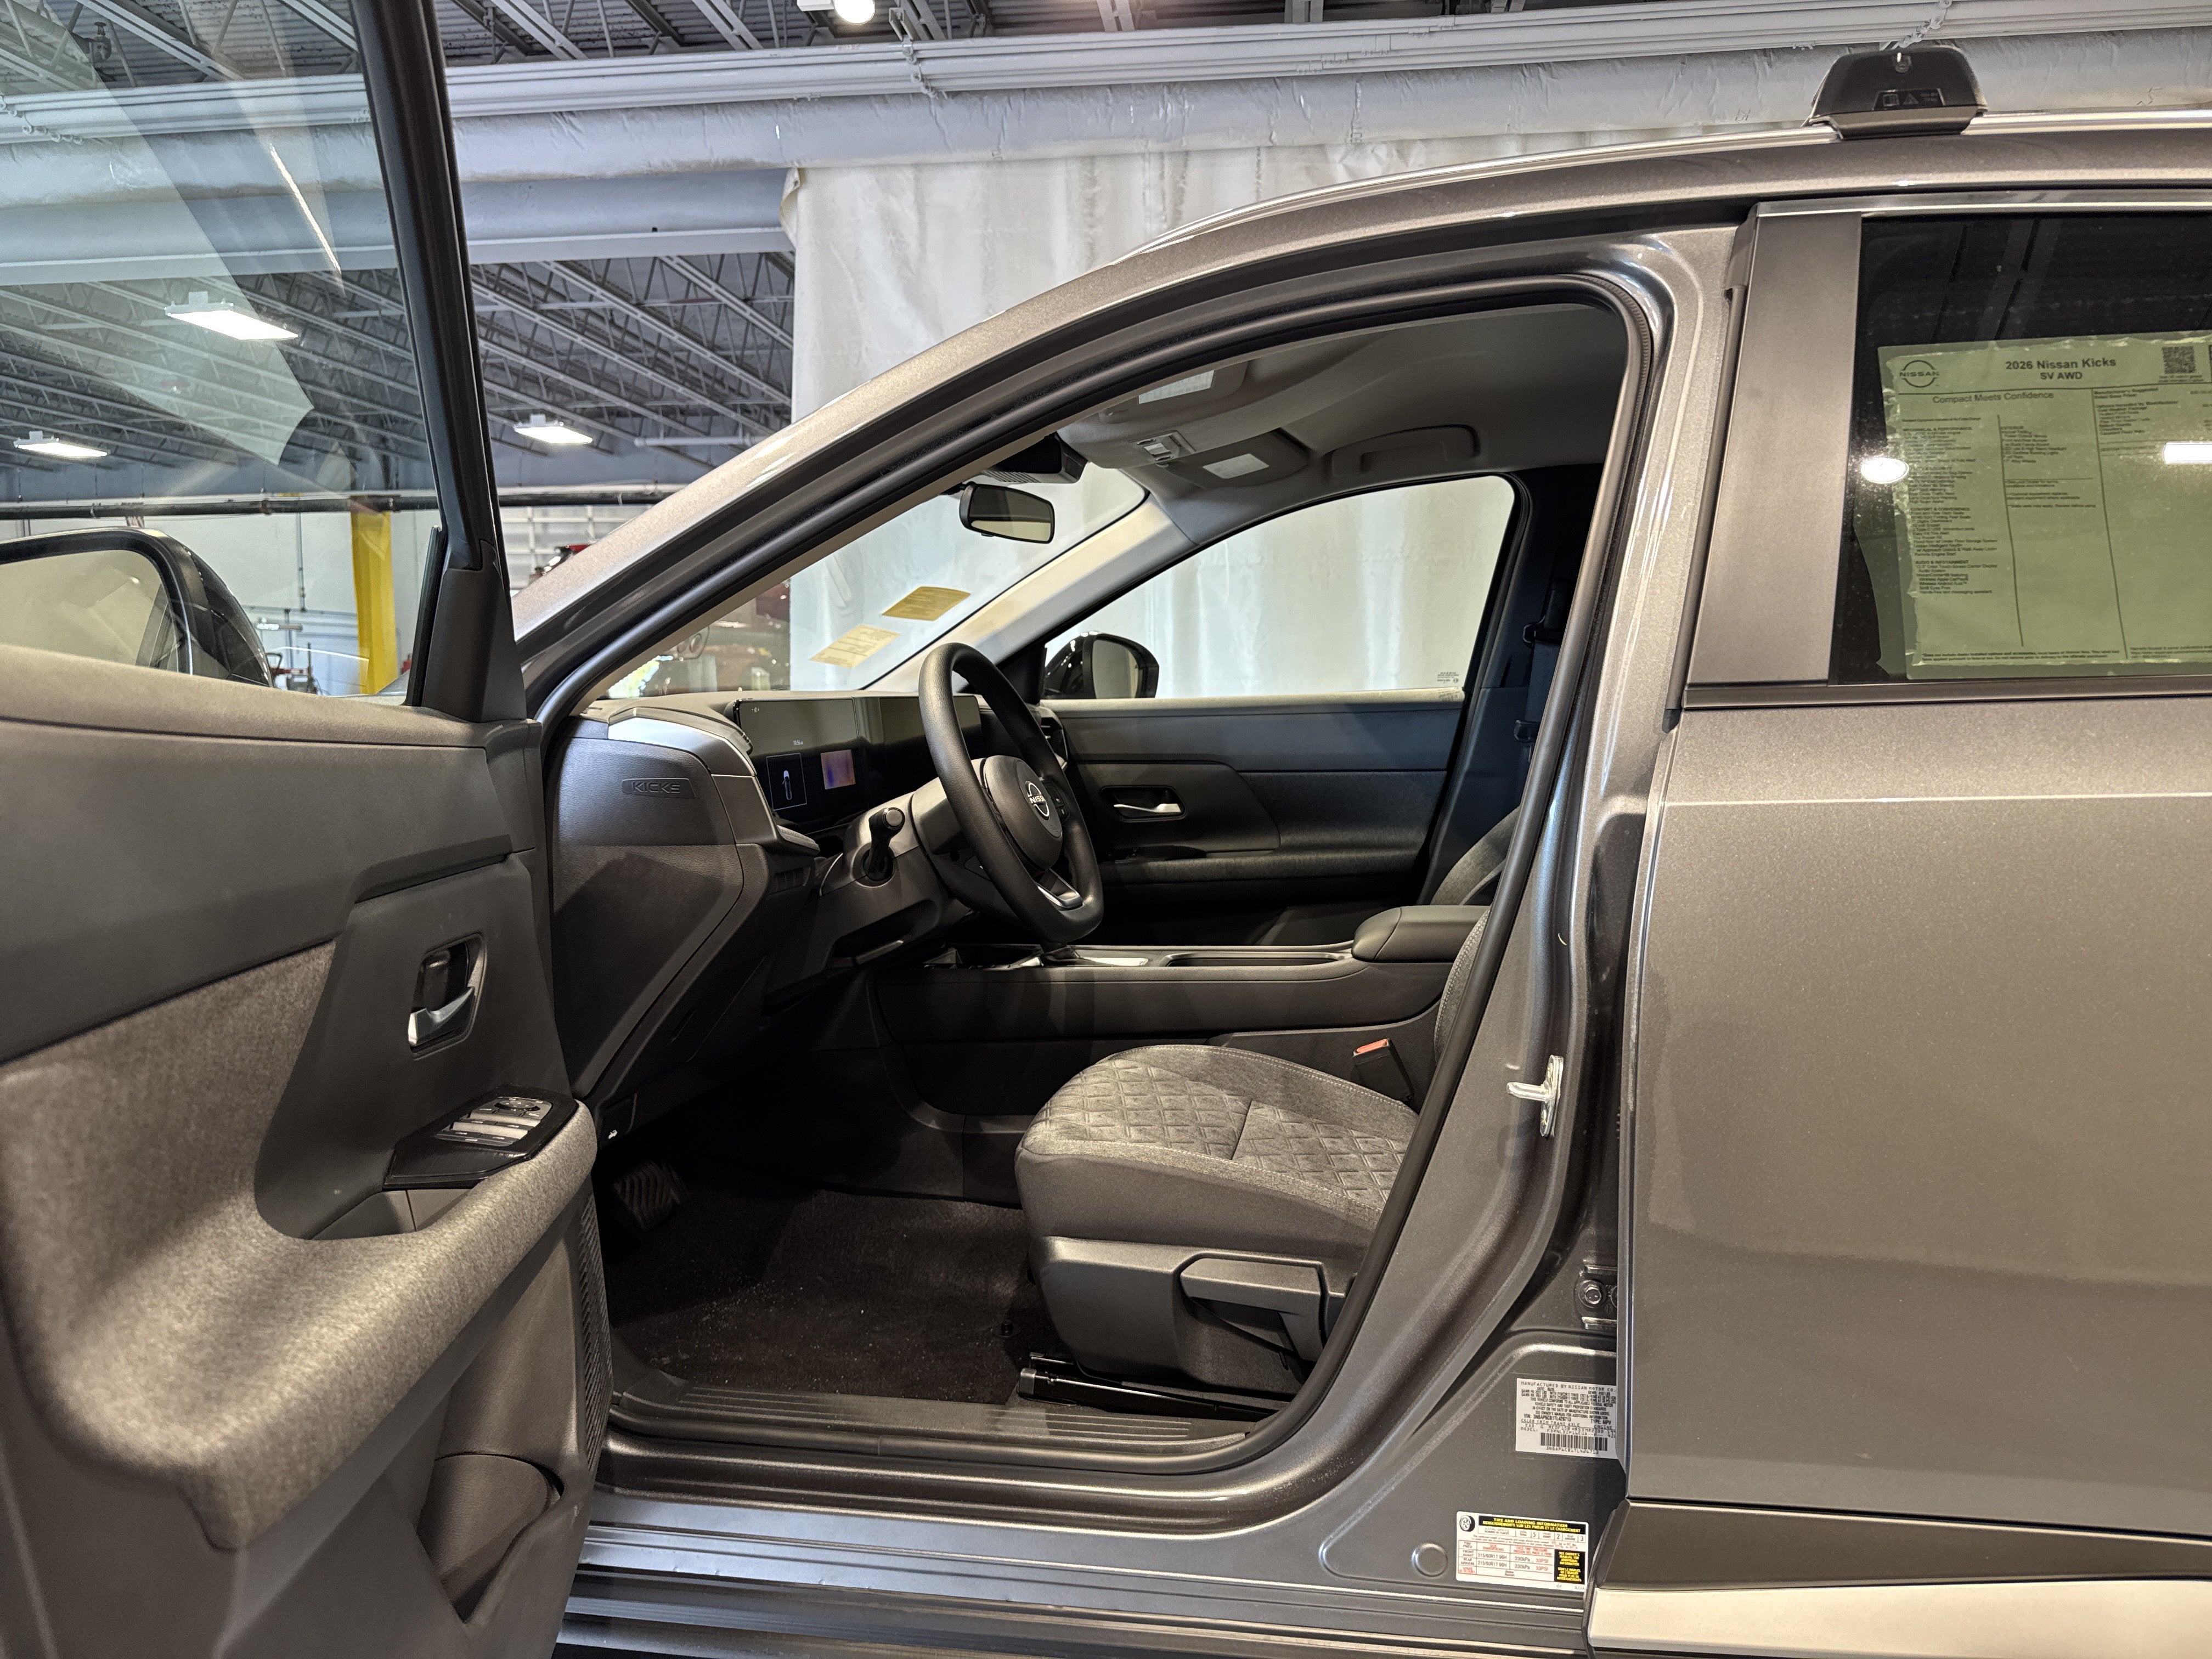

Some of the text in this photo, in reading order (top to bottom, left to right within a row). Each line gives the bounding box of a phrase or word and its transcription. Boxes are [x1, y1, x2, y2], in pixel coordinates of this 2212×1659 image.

[2006, 358, 2116, 370] 2026 Nissan Kicks
[1932, 391, 2054, 404] Compact Meets Confidence
[632, 782, 681, 793] KICKS
